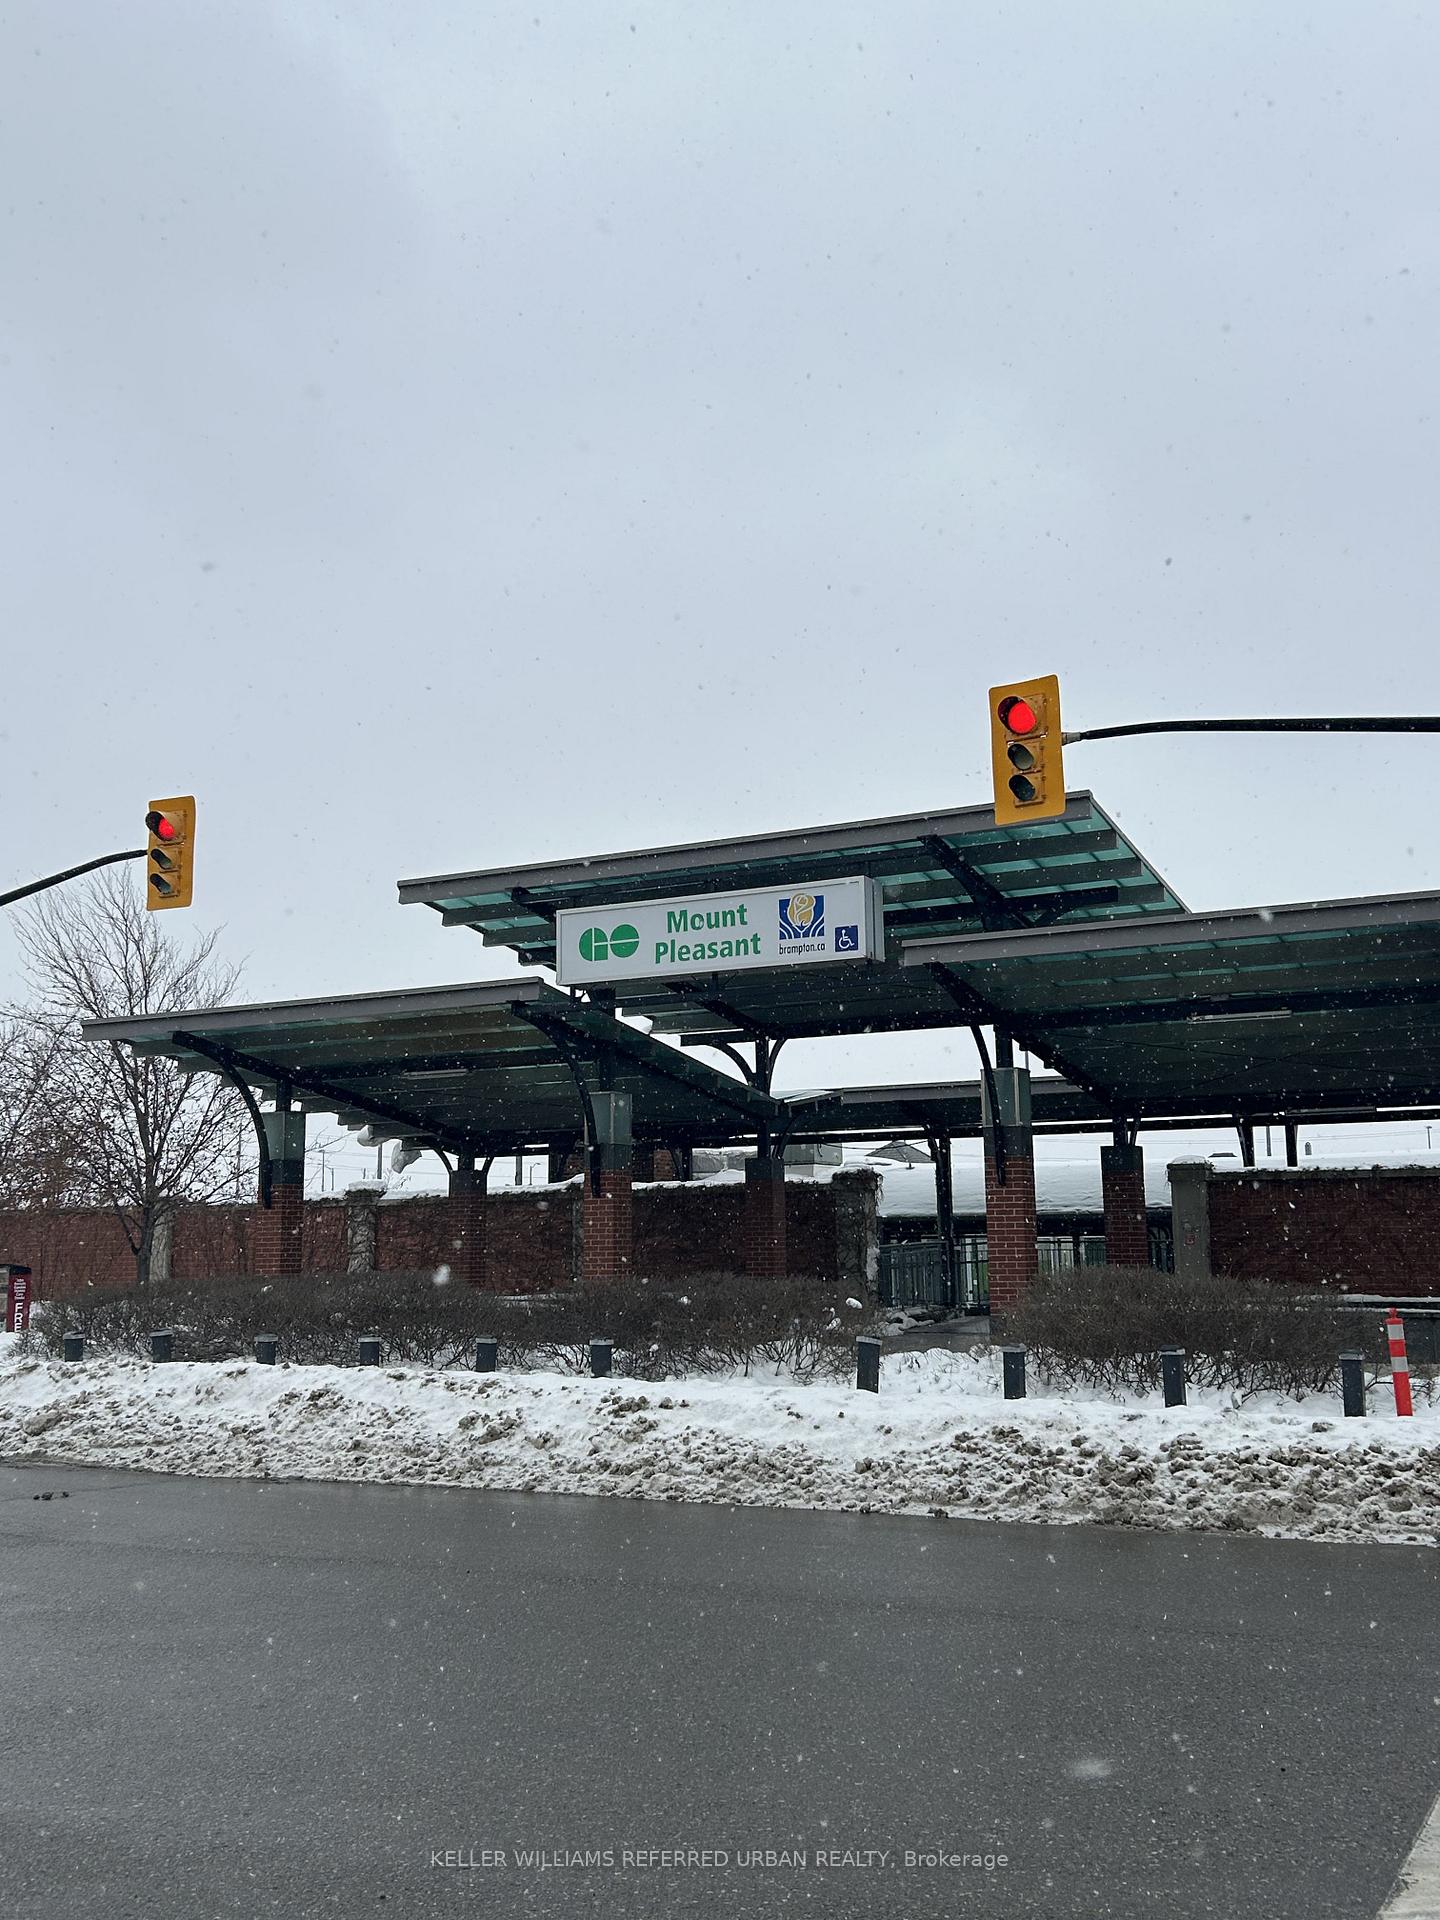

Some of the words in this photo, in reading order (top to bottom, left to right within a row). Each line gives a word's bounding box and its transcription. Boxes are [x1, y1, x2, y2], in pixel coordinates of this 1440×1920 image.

[667, 903, 748, 933] Mount
[579, 924, 640, 962] GO
[655, 933, 761, 964] Pleasant
[779, 943, 825, 956] brampton.ca
